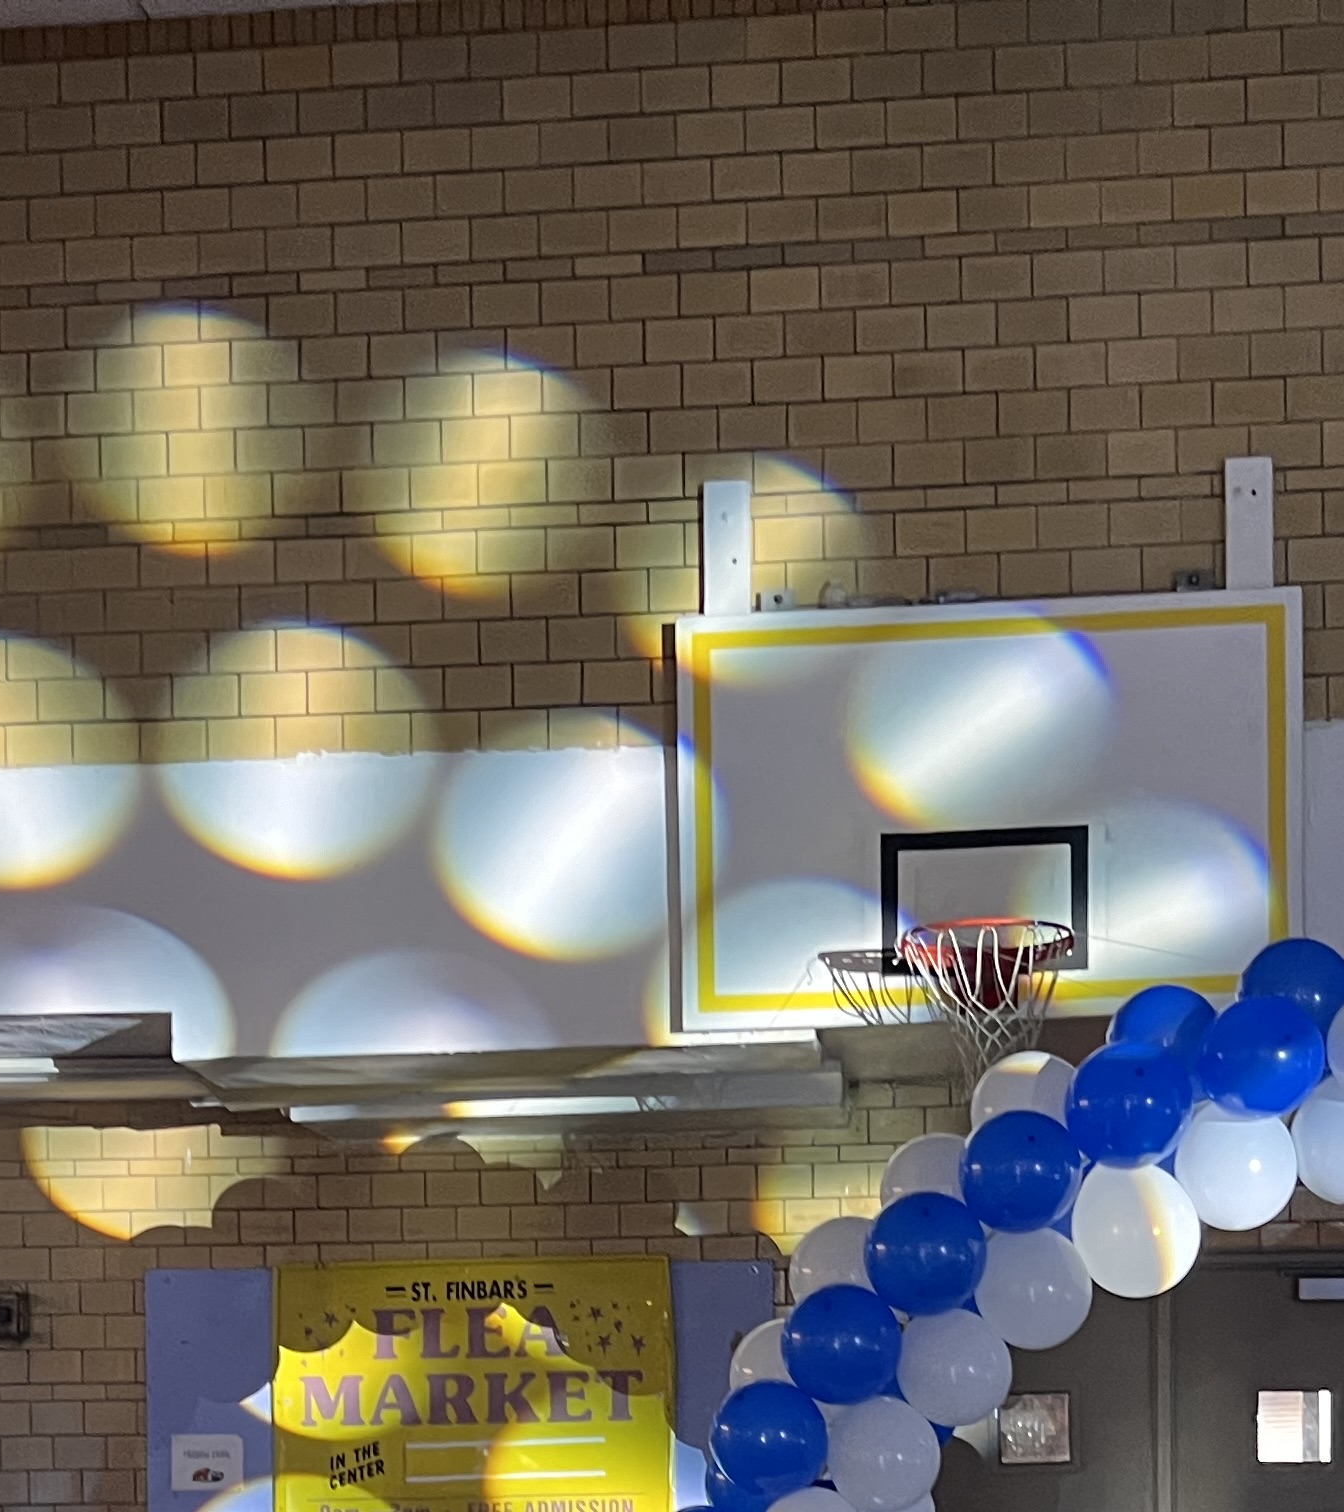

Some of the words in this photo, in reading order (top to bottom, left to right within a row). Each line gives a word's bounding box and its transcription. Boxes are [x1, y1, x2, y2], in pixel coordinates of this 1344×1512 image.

[411, 1281, 437, 1302] ST.
[373, 1306, 569, 1360] FLEA
[300, 1368, 644, 1427] MARKET
[329, 1452, 346, 1471] IN
[353, 1441, 381, 1464] THE
[329, 1459, 385, 1490] CENTER
